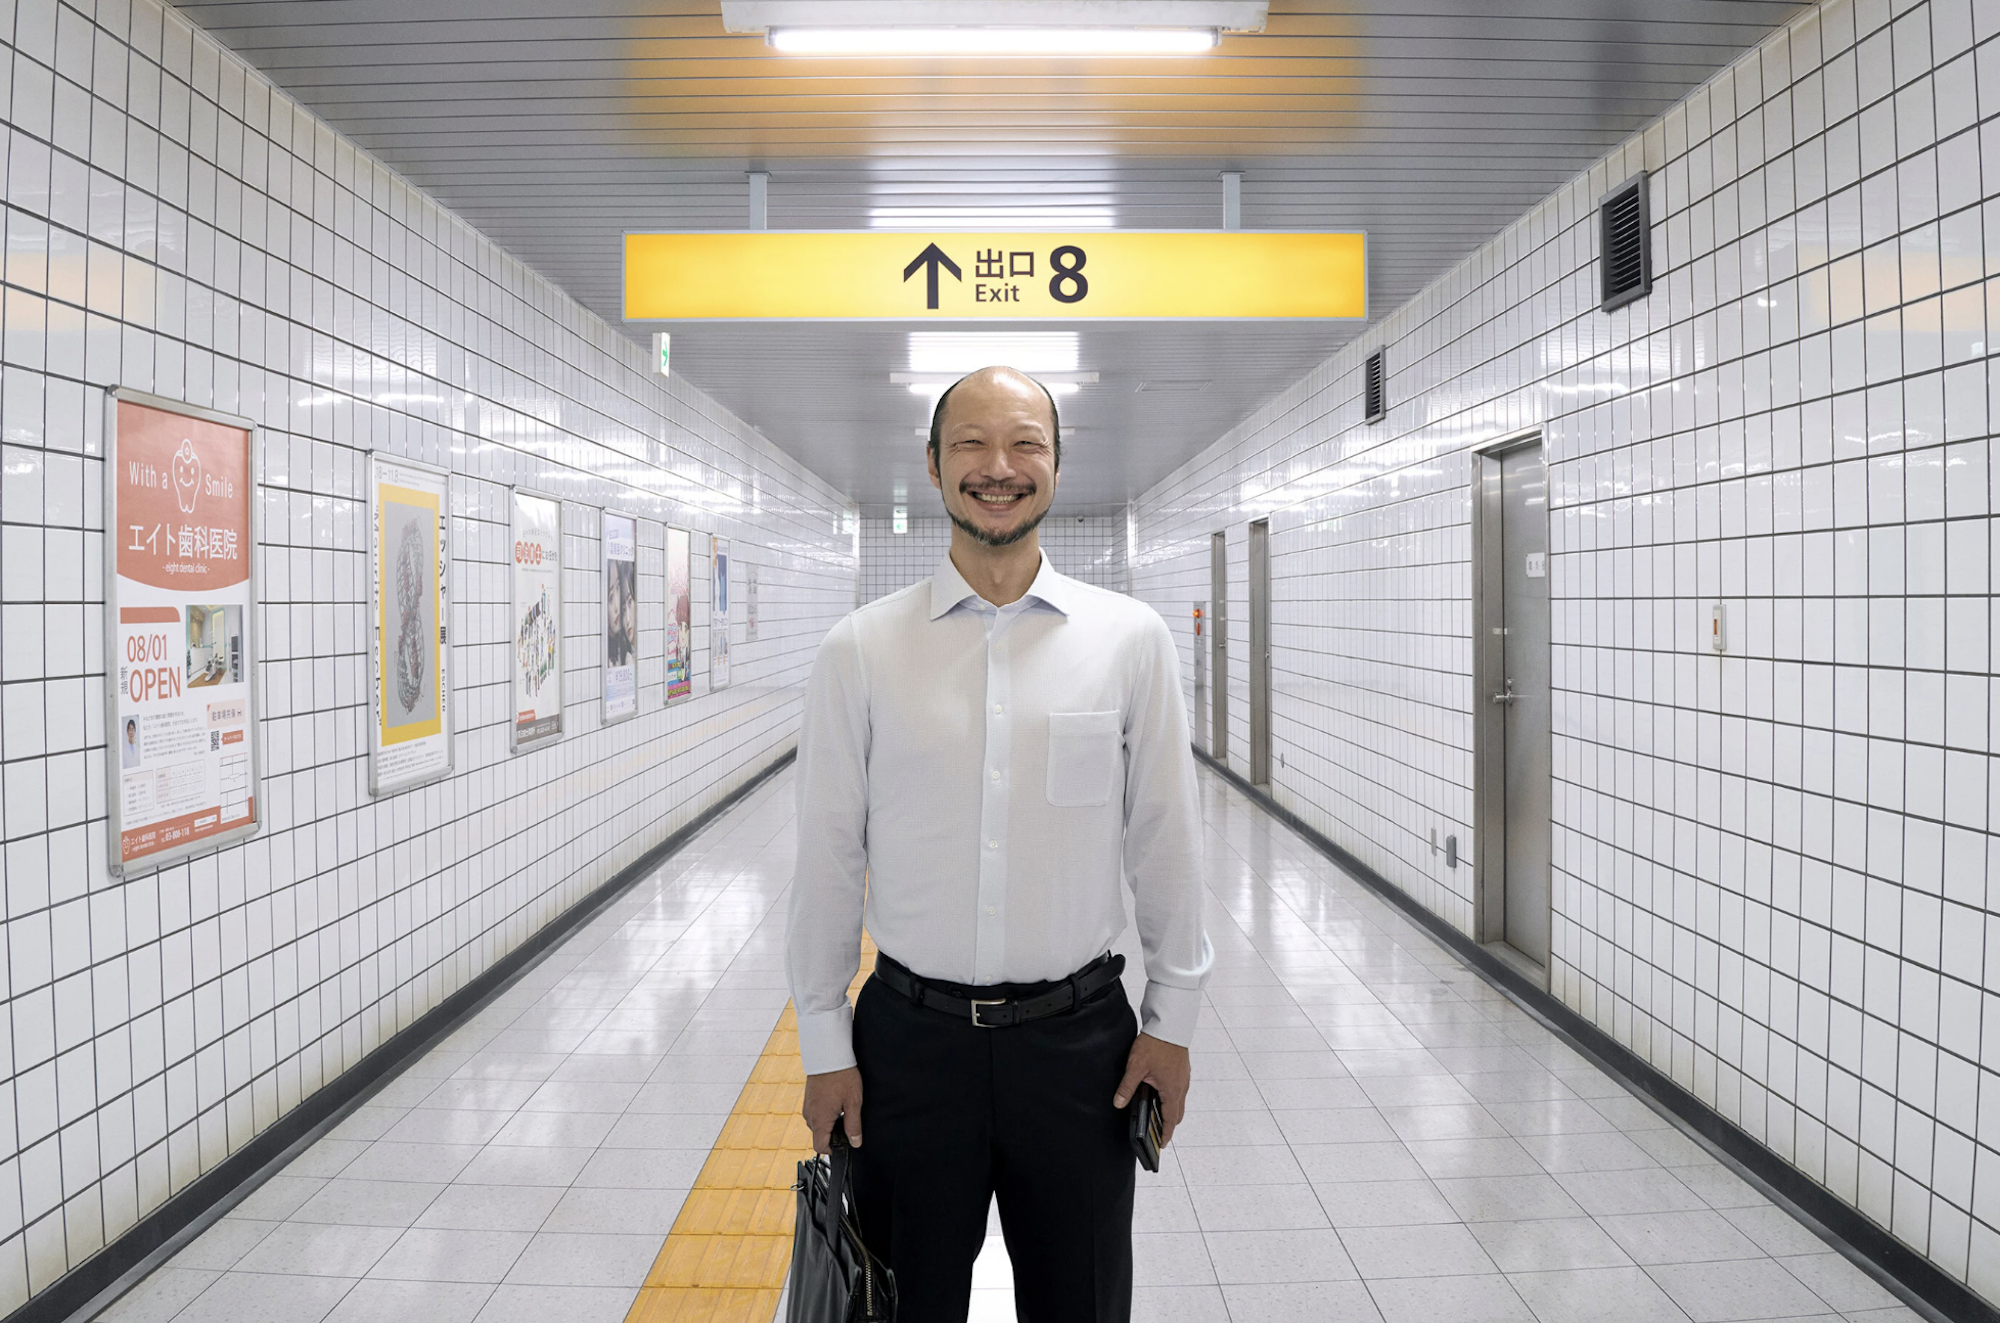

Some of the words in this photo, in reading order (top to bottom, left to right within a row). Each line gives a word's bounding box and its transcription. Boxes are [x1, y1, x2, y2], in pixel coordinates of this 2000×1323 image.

[975, 248, 1034, 279] 出口
[1048, 245, 1089, 304] 8
[975, 283, 1020, 302] Exit
[129, 461, 156, 488] With
[162, 473, 168, 490] a
[205, 474, 233, 499] Smile
[128, 523, 237, 560] エイト歯科医院
[165, 562, 179, 575] eight
[180, 562, 195, 573] dental
[195, 563, 207, 573] clinic
[127, 634, 167, 663] 08/01
[130, 666, 181, 703] OPEN
